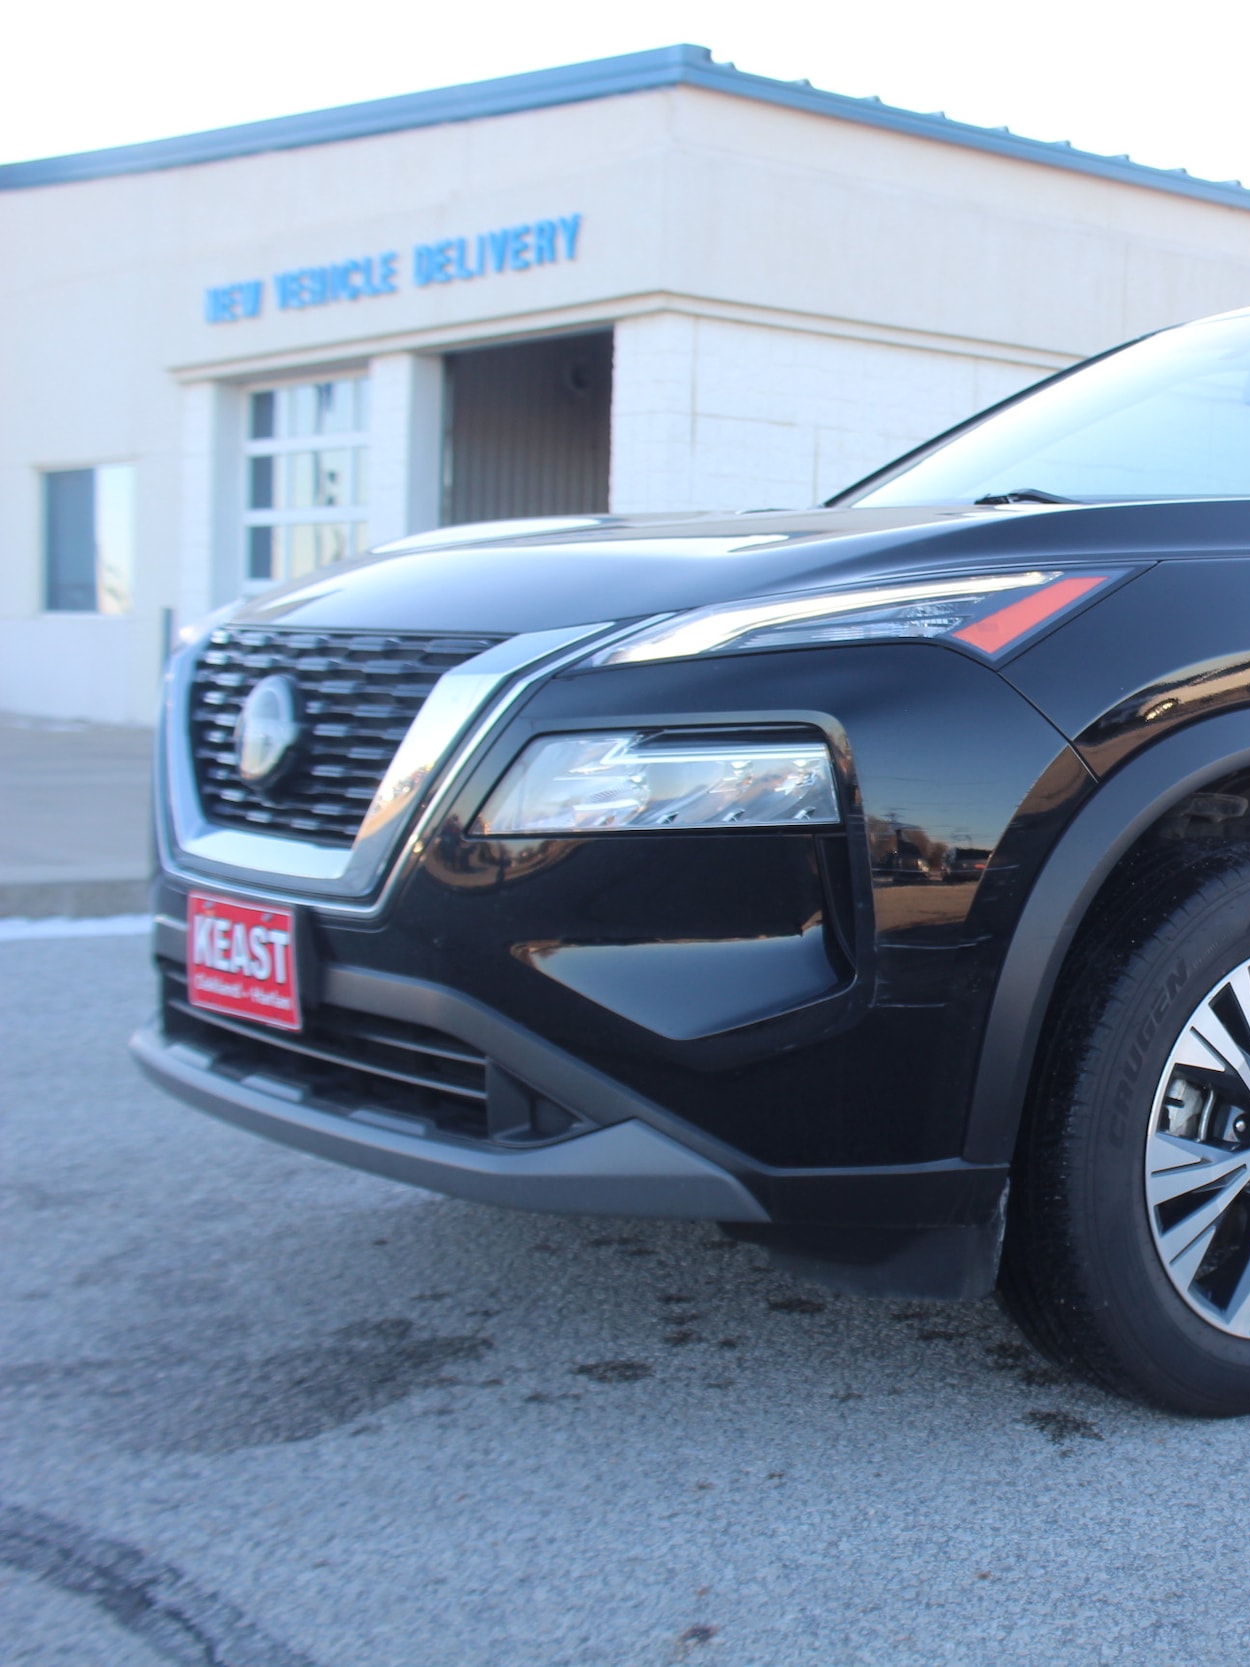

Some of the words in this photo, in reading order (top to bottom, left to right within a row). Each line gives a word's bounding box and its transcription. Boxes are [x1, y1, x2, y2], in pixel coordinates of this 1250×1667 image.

[206, 280, 263, 323] NEW
[273, 252, 399, 310] VEHICLE
[413, 213, 582, 287] DELIVERY
[193, 914, 289, 985] KEAST
[1109, 958, 1187, 1148] CRUGEN
